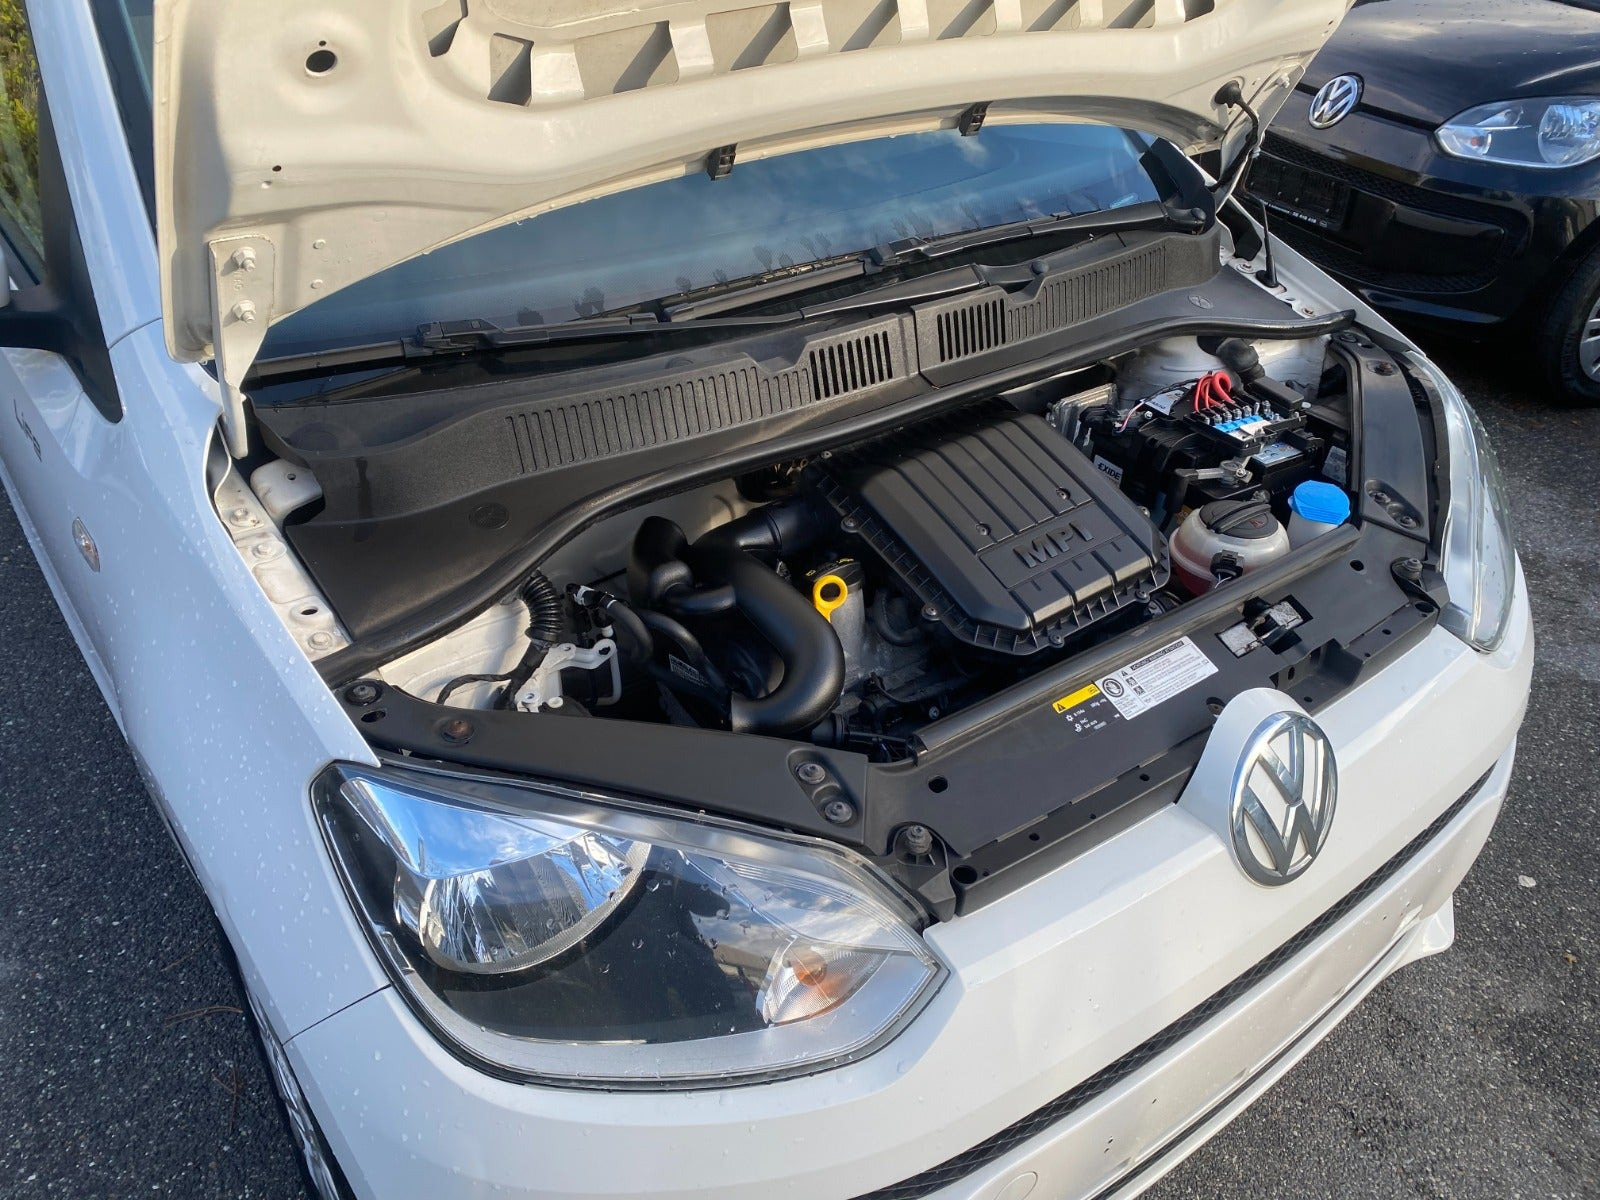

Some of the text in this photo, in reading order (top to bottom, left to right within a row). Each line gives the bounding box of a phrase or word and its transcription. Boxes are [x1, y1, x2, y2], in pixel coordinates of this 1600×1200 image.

[1309, 76, 1357, 128] VW
[1097, 462, 1121, 481] EXIDE
[1012, 521, 1095, 568] MPI
[1229, 711, 1338, 886] VW
